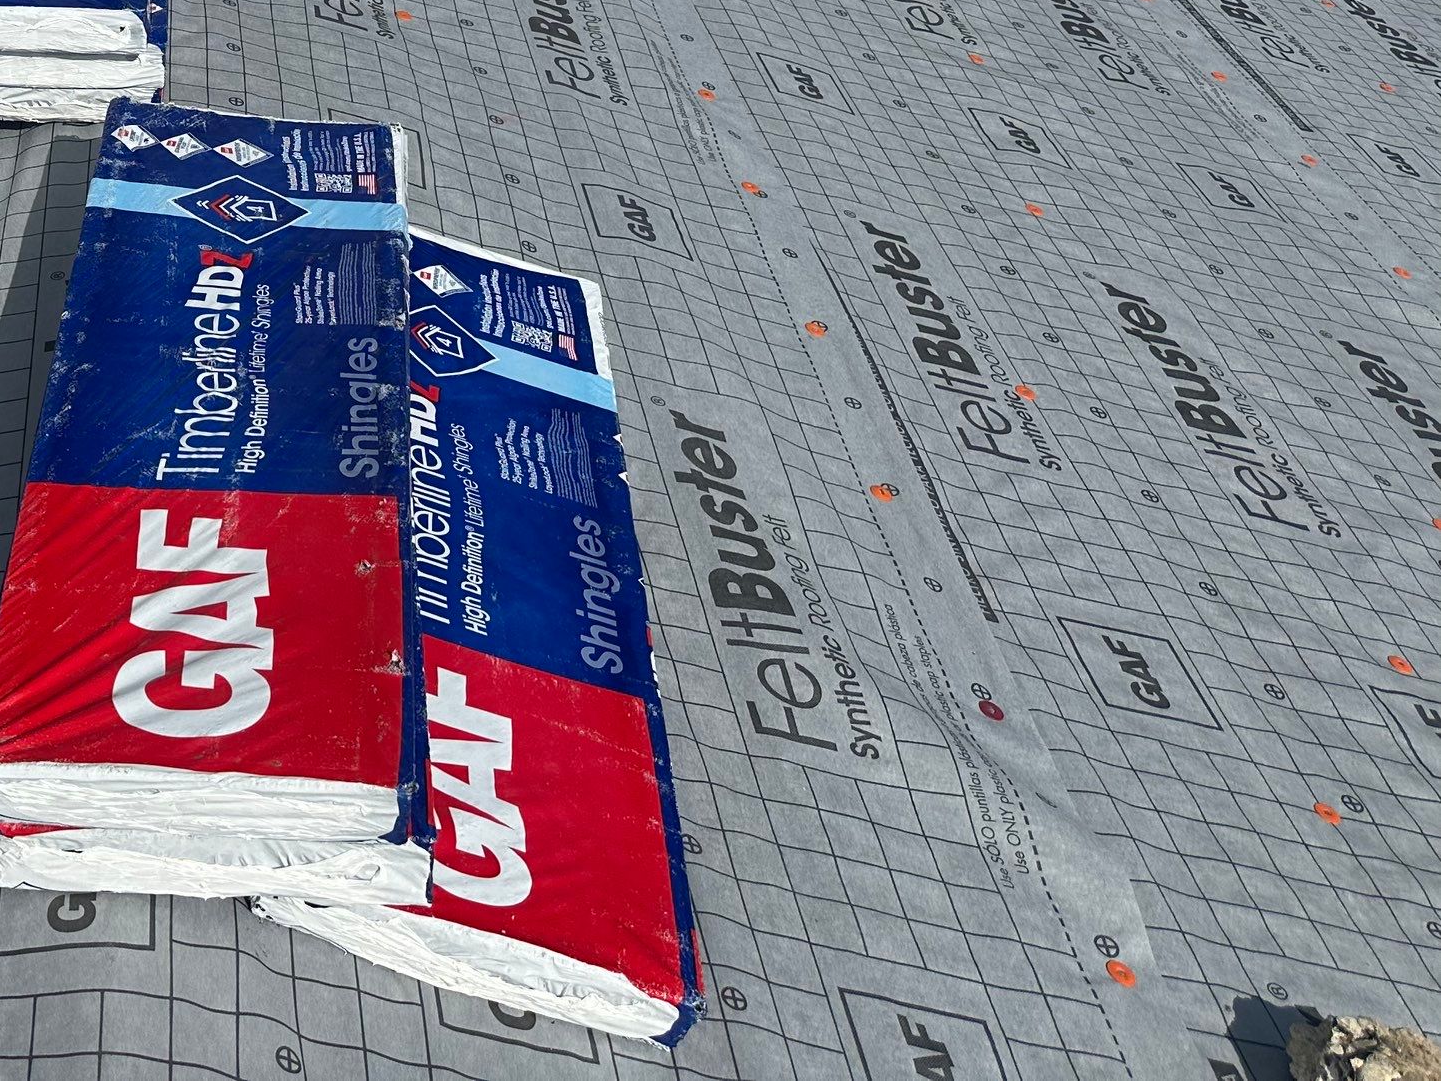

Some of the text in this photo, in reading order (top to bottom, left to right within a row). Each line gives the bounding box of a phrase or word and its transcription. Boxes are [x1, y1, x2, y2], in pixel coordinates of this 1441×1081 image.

[582, 10, 606, 57] Roofing
[595, 55, 628, 106] Synthetic
[786, 63, 824, 100] GAF
[355, 145, 364, 154] THE
[999, 114, 1042, 156] GAF
[356, 159, 366, 173] MADE
[1374, 142, 1420, 178] GAF
[1208, 171, 1256, 208] GAF
[617, 195, 657, 242] GAF
[553, 300, 562, 311] THE
[557, 317, 565, 332] MADE
[436, 337, 453, 348] 4
[860, 220, 1030, 465] FeltBuster
[235, 441, 265, 473] High
[252, 285, 274, 329] Shingles
[338, 337, 379, 478] Shingles
[1100, 281, 1310, 533] FeltBuster
[1228, 388, 1278, 453] Roofing
[450, 424, 471, 474] Shingles
[510, 445, 518, 461] Algae
[522, 425, 530, 437] Area
[537, 433, 546, 462] Technology
[1007, 389, 1063, 473] Synthetic
[512, 462, 521, 484] 25-year
[1270, 452, 1342, 540] Synthetic
[573, 515, 623, 672] Shingles
[669, 408, 838, 753] FeltBuster
[785, 553, 834, 633] Roofing
[112, 508, 274, 738] GAF
[461, 595, 488, 634] High
[885, 604, 904, 640] plástica
[897, 643, 917, 676] cabeza
[914, 635, 934, 668] staples
[1101, 635, 1171, 710] GAF
[819, 633, 881, 760] Synthetic
[927, 671, 941, 688] cap
[422, 668, 533, 910] GAF
[971, 774, 995, 824] puntillas
[987, 770, 1029, 874] Use ONLY plastic
[1001, 869, 1014, 887] Use
